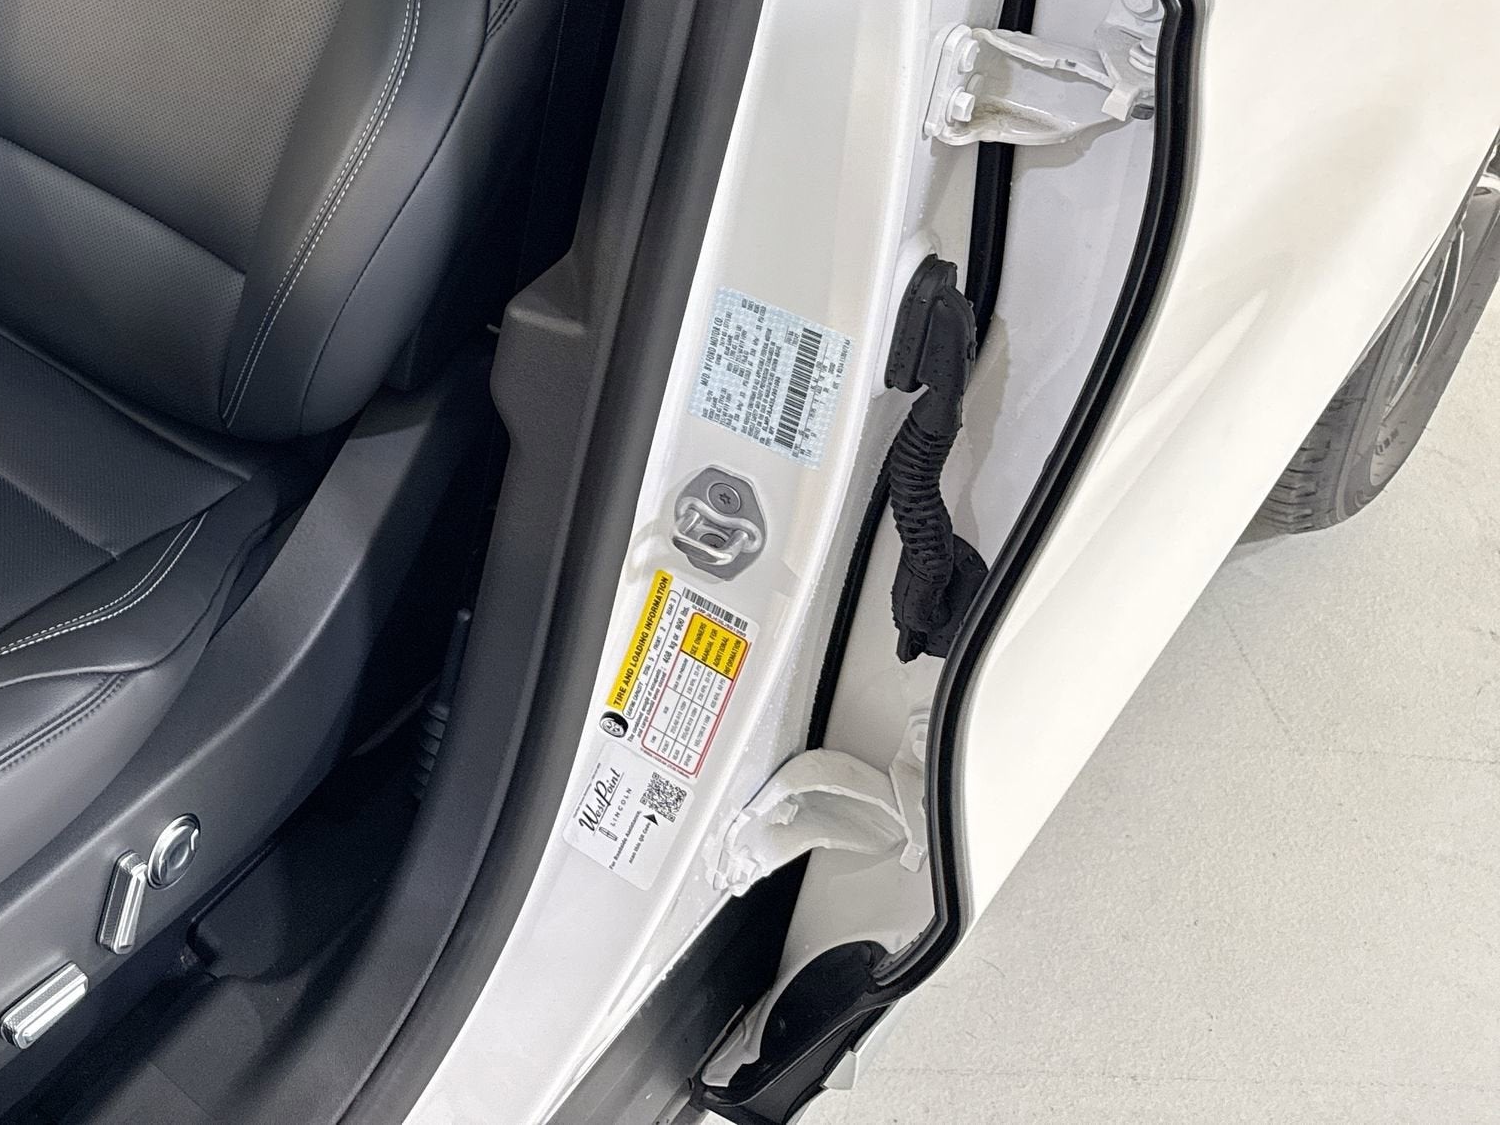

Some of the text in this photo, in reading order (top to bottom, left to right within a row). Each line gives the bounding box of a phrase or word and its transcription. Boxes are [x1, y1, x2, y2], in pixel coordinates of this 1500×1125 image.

[709, 326, 720, 346] MOTOR
[703, 362, 712, 371] BY
[705, 346, 716, 362] FORD
[613, 576, 668, 705] TIRE AND LOADING INFORMATION
[662, 650, 672, 663] 408
[667, 640, 677, 649] kg
[675, 617, 684, 630] 900
[689, 622, 706, 655] SEE OWNERS
[701, 628, 717, 662] MANUAL FOR
[713, 636, 728, 667] ADDITIONAL
[723, 639, 741, 674] INFORMATION
[632, 681, 643, 700] CAPACITY
[626, 733, 634, 742] The
[632, 711, 643, 733] combined
[641, 696, 649, 711] weight
[579, 767, 620, 831] WestPoint
[610, 787, 631, 826] LINCOLN
[642, 822, 650, 834] Code
[613, 837, 627, 860] Roadside
